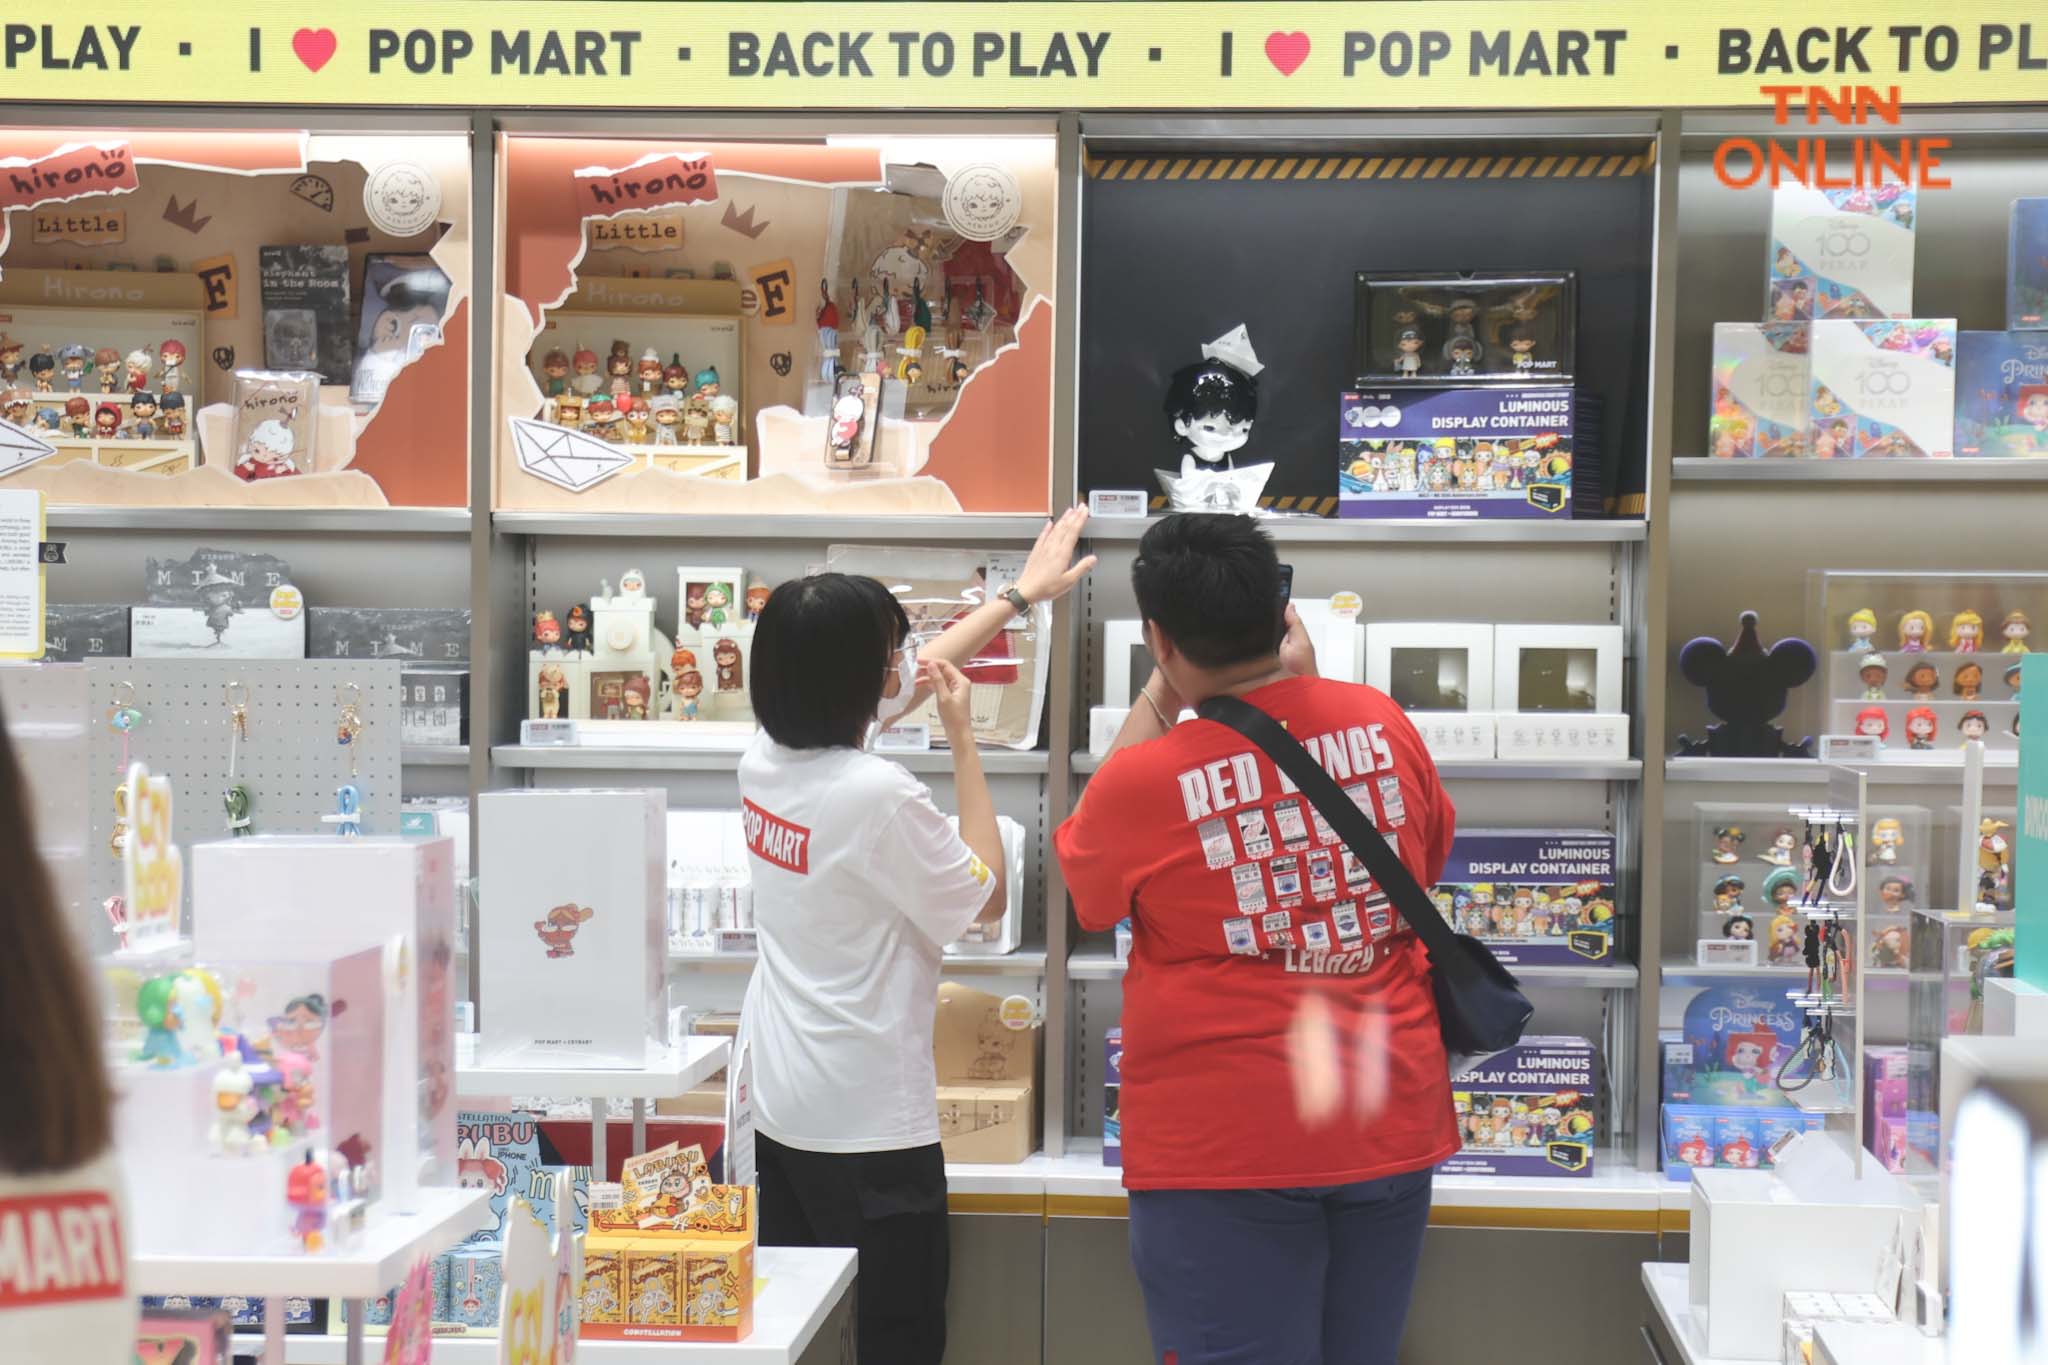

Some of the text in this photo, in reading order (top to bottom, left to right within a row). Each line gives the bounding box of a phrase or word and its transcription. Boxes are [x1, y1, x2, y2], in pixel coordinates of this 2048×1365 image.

[5, 23, 2048, 77] PLAY I POP MART BACK TO PLAY I POP MART BACK TO PL
[9, 152, 126, 195] hirono
[590, 162, 708, 205] hirono
[37, 214, 120, 233] Little
[595, 223, 678, 240] Little
[198, 264, 232, 312] F
[308, 279, 340, 289] Room
[756, 269, 791, 318] F
[1499, 400, 1569, 414] LUMINOUS
[1431, 414, 1569, 429] DISPLAY CONTAINER
[1177, 752, 1263, 822] RED
[762, 819, 806, 867] MART
[1538, 848, 1611, 860] LUMINOUS
[1468, 862, 1611, 875] DISPLAY CONTAINER
[1516, 1056, 1591, 1070] LUMINOUS
[1507, 1071, 1591, 1085] CONTAINER
